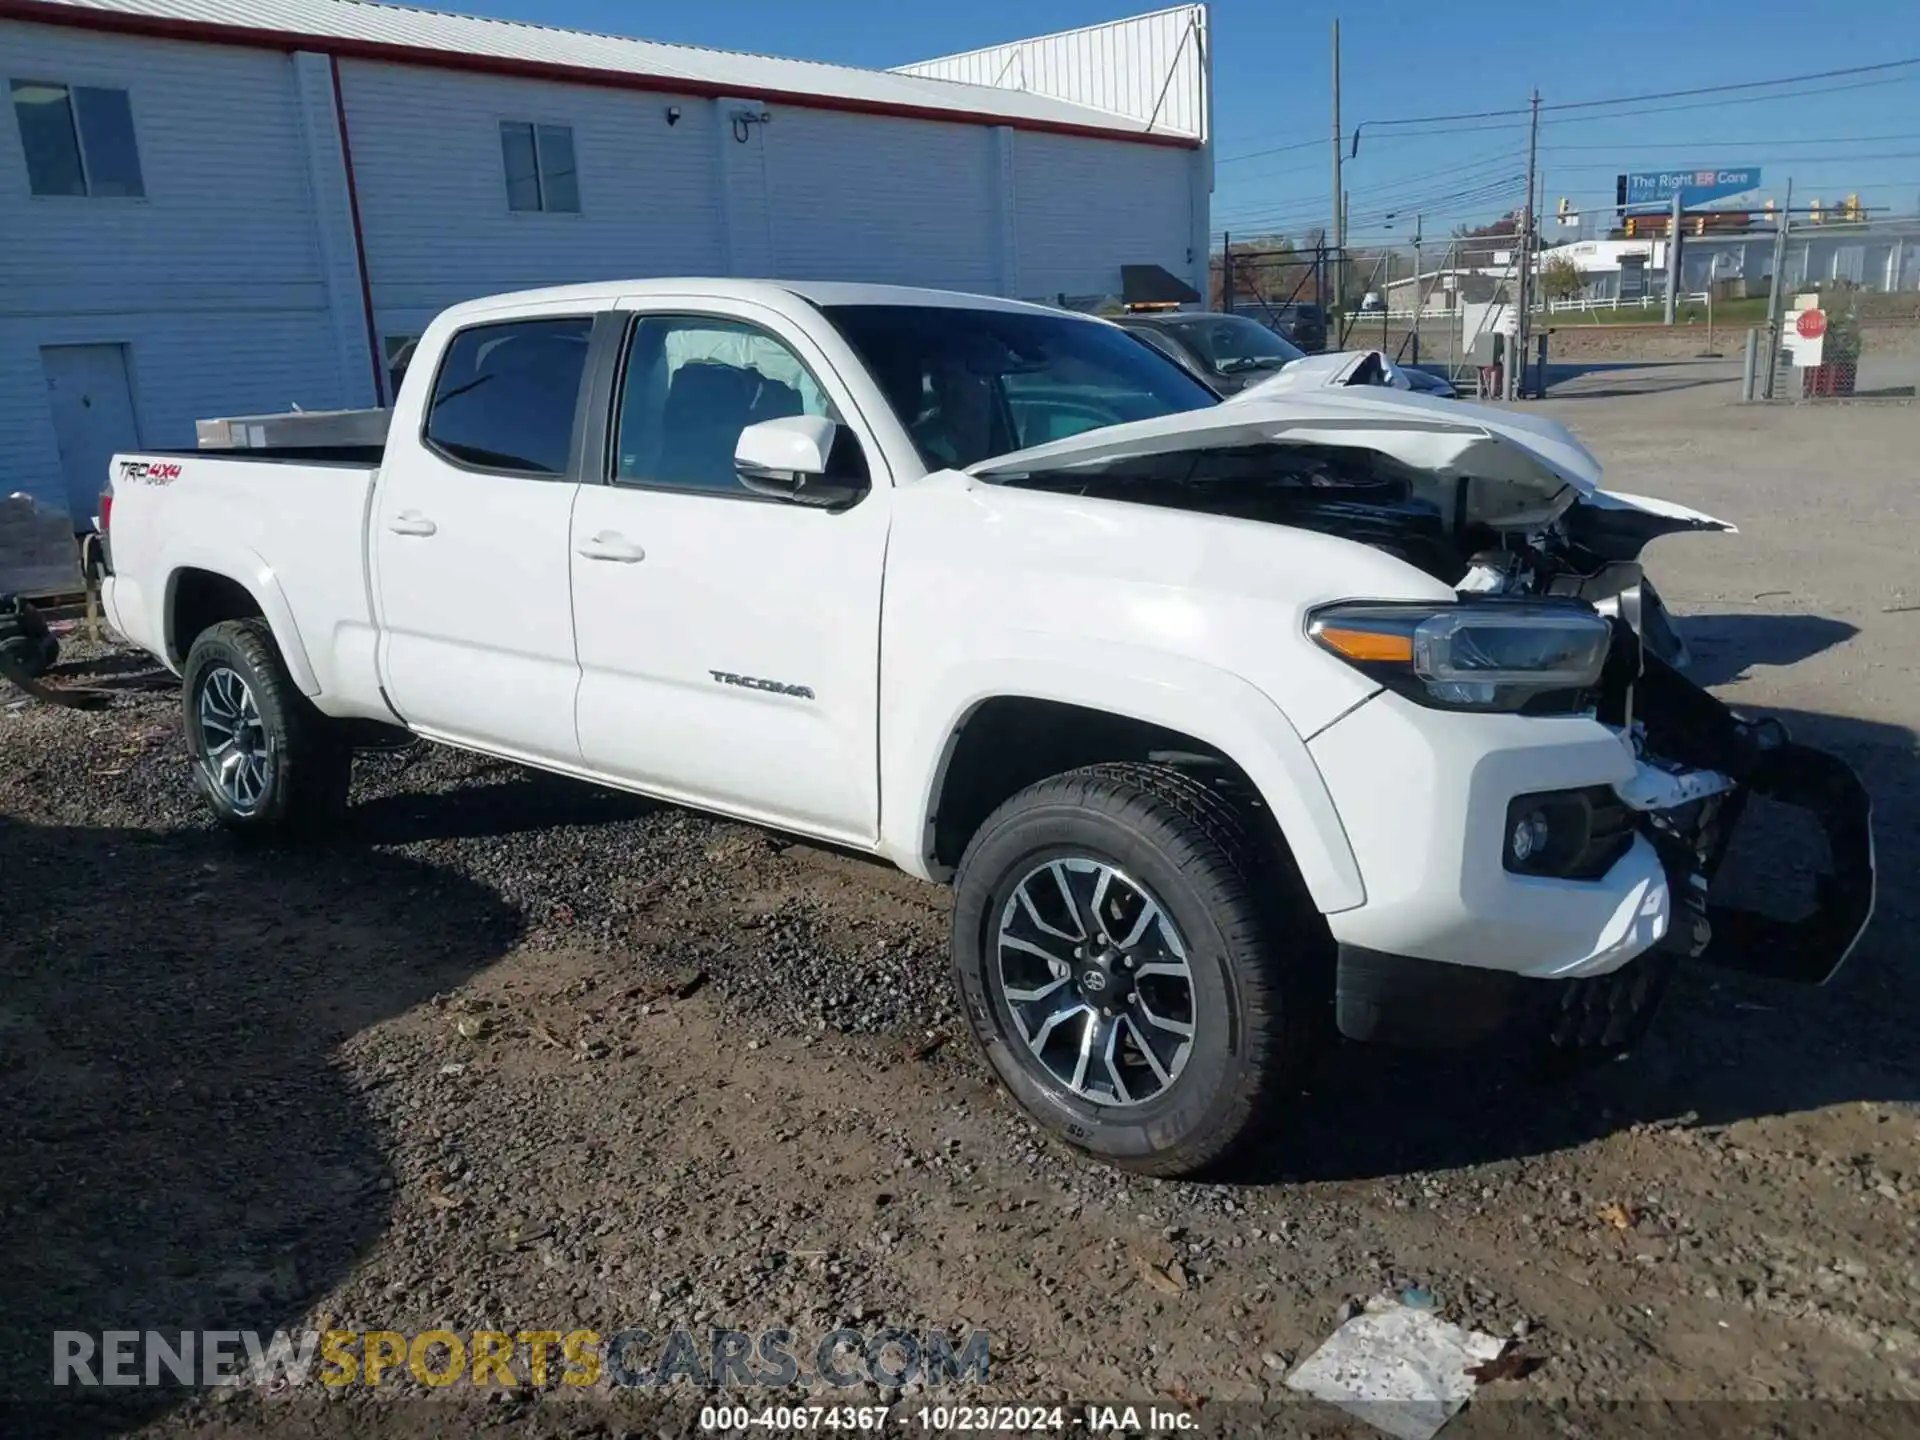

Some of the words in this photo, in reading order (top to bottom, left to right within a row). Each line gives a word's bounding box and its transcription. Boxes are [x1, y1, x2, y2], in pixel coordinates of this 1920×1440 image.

[1632, 175, 1656, 188] The
[1659, 173, 1693, 189] Right
[1695, 172, 1715, 186] ER
[1717, 171, 1748, 185] Care
[1798, 319, 1825, 330] STOP
[708, 669, 815, 700] TACOMA
